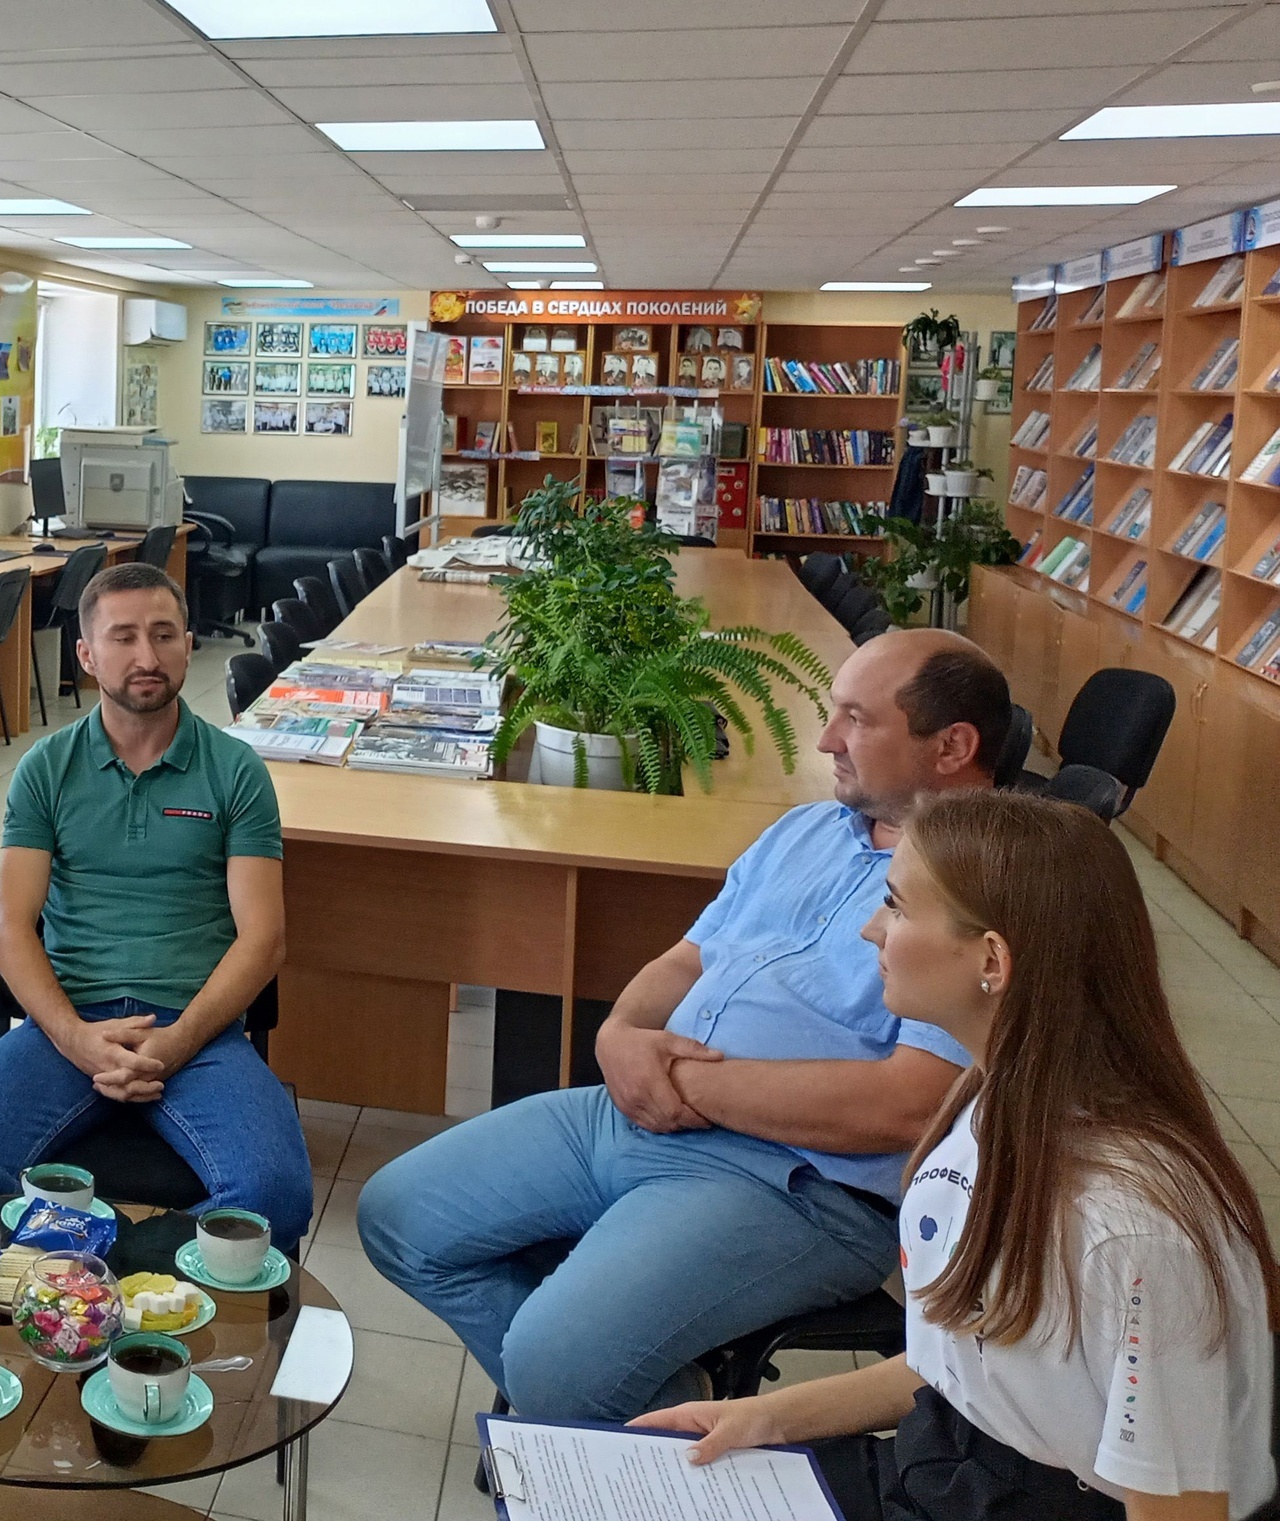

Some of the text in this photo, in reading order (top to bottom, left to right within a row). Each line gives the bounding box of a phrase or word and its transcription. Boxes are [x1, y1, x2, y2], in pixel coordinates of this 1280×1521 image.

[466, 299, 727, 318] ПОБЕДА В СЕРДЦАХ ПОКОЛЕНИЙ
